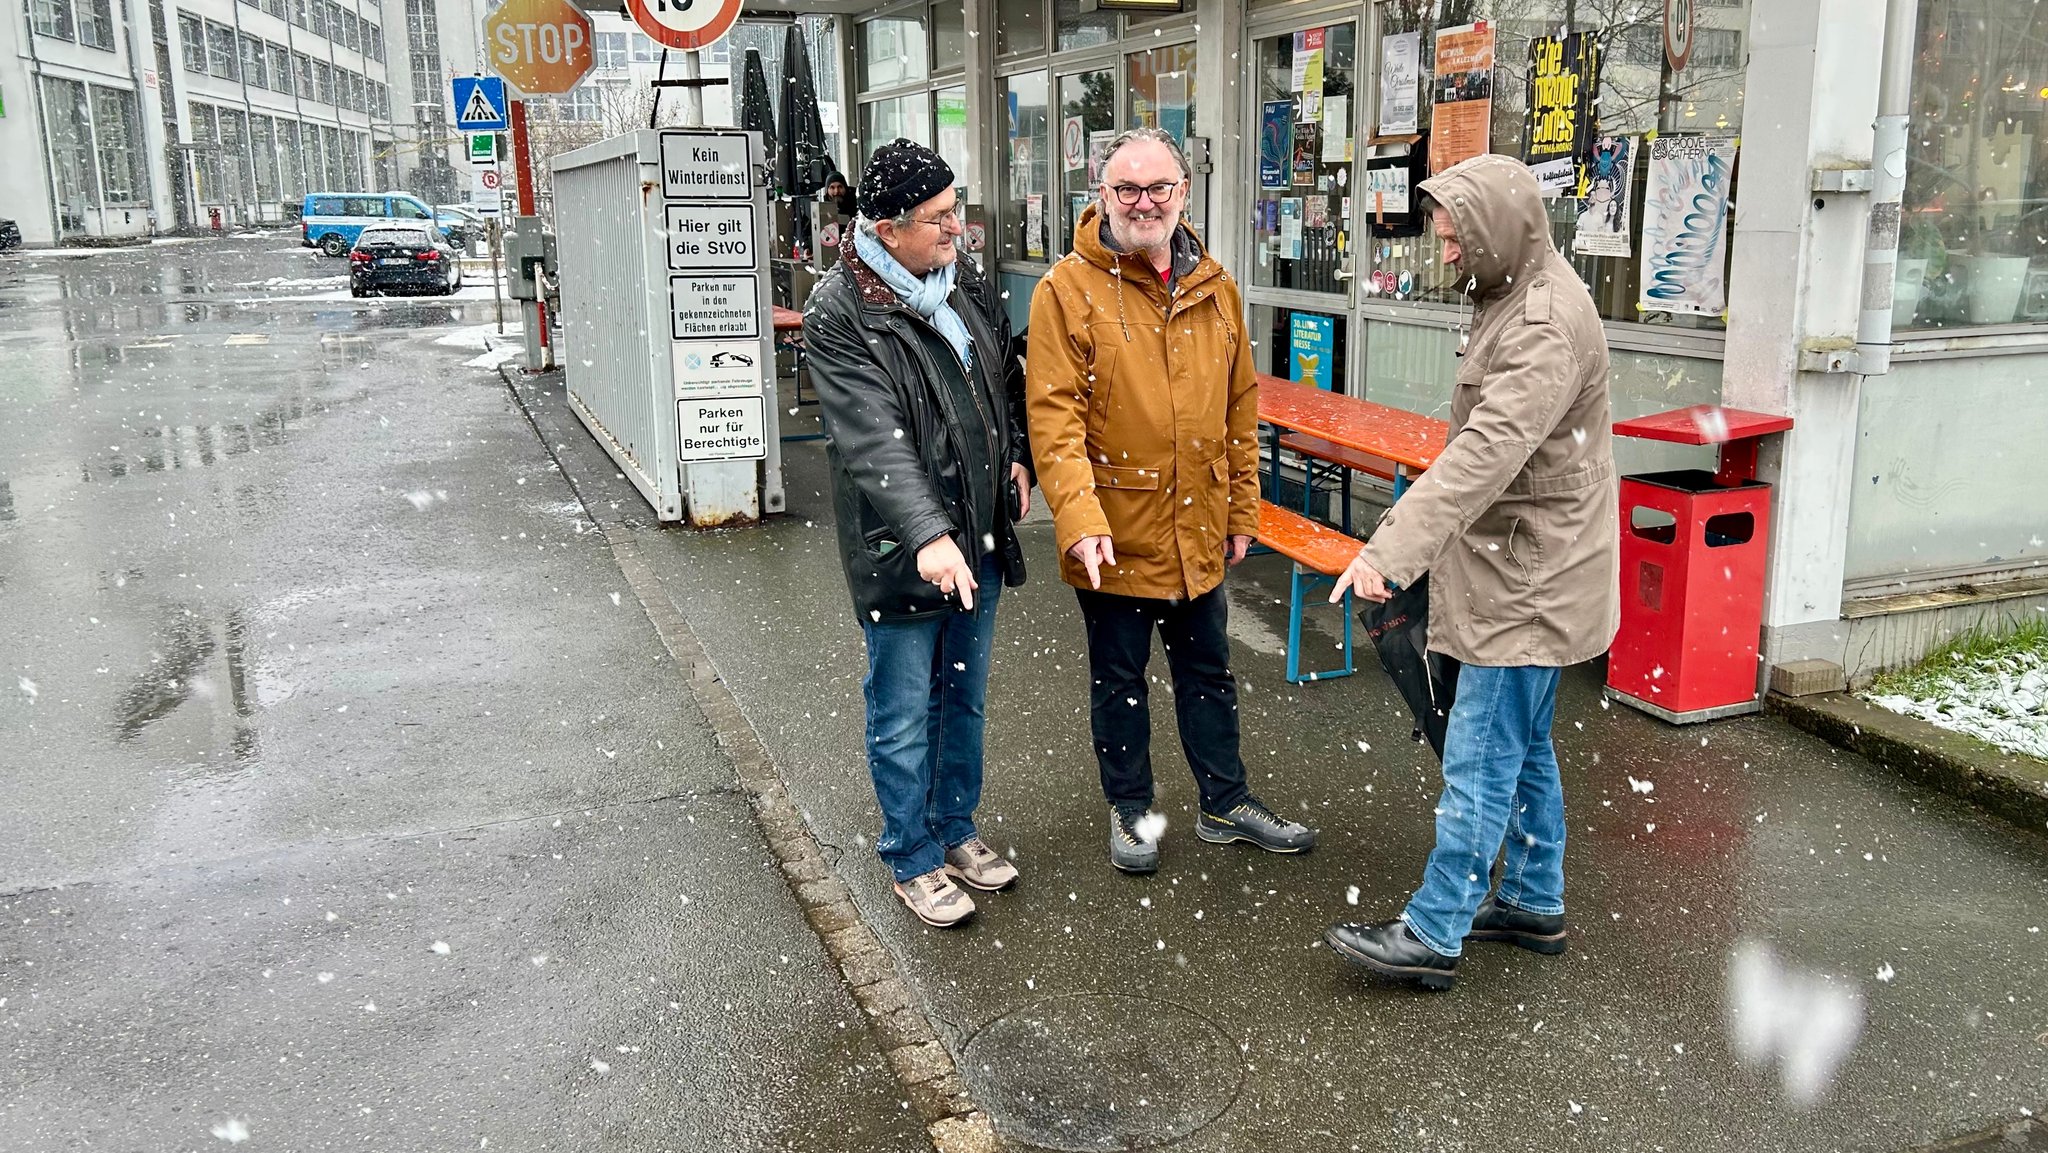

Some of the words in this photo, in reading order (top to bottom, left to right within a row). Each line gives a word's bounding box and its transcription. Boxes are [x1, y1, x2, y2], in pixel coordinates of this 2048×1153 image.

[496, 23, 583, 65] STOP
[1537, 36, 1563, 76] the
[1535, 67, 1578, 110] magic
[1265, 105, 1276, 114] FAU
[1533, 106, 1575, 143] tones
[1669, 137, 1704, 149] GROOVE
[692, 147, 719, 162] Kein
[1668, 148, 1715, 160] GATHERING
[668, 170, 745, 185] Winterdienst
[678, 219, 710, 232] Hier
[717, 219, 742, 235] gilt
[676, 241, 699, 254] die
[707, 241, 746, 254] StVO
[691, 282, 719, 292] Parken
[723, 283, 736, 291] nur
[702, 296, 710, 305] in
[713, 295, 727, 305] den
[679, 309, 751, 320] gekennzeichneten
[684, 322, 716, 333] Flächen
[719, 322, 747, 331] erlaubt
[1294, 329, 1321, 341] LITERATUR
[1294, 339, 1311, 350] MESSE
[699, 408, 743, 419] Parken
[700, 425, 720, 434] nur
[726, 422, 743, 432] für
[684, 436, 760, 450] Berechtigte
